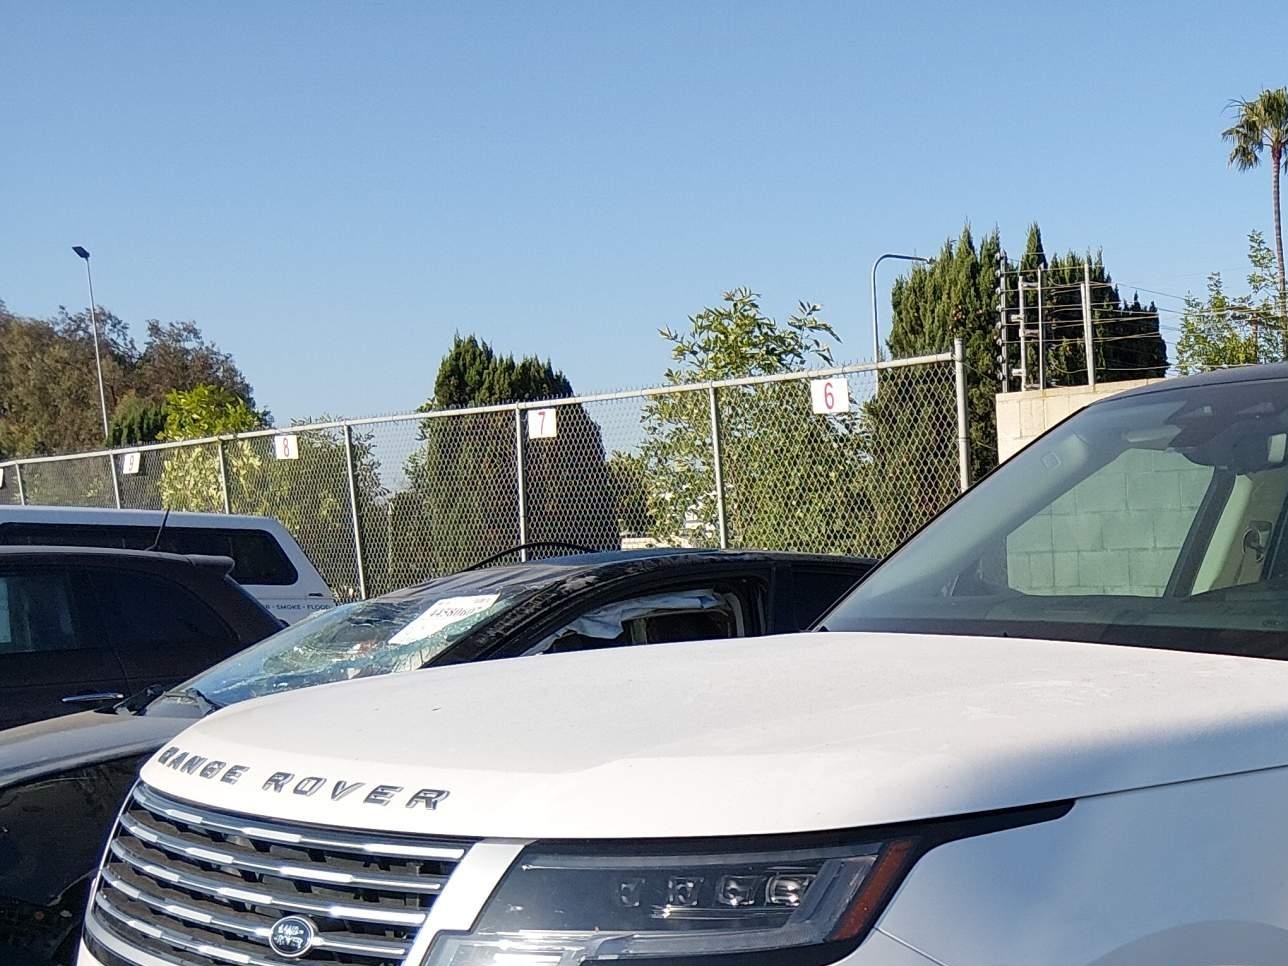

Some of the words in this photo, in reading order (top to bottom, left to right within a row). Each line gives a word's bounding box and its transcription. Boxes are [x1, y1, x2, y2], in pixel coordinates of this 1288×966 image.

[824, 382, 835, 410] 6
[536, 411, 546, 436] 7
[283, 437, 290, 458] 8
[128, 455, 136, 471] 9
[156, 746, 251, 785] RANGE
[261, 771, 450, 811] ROVER
